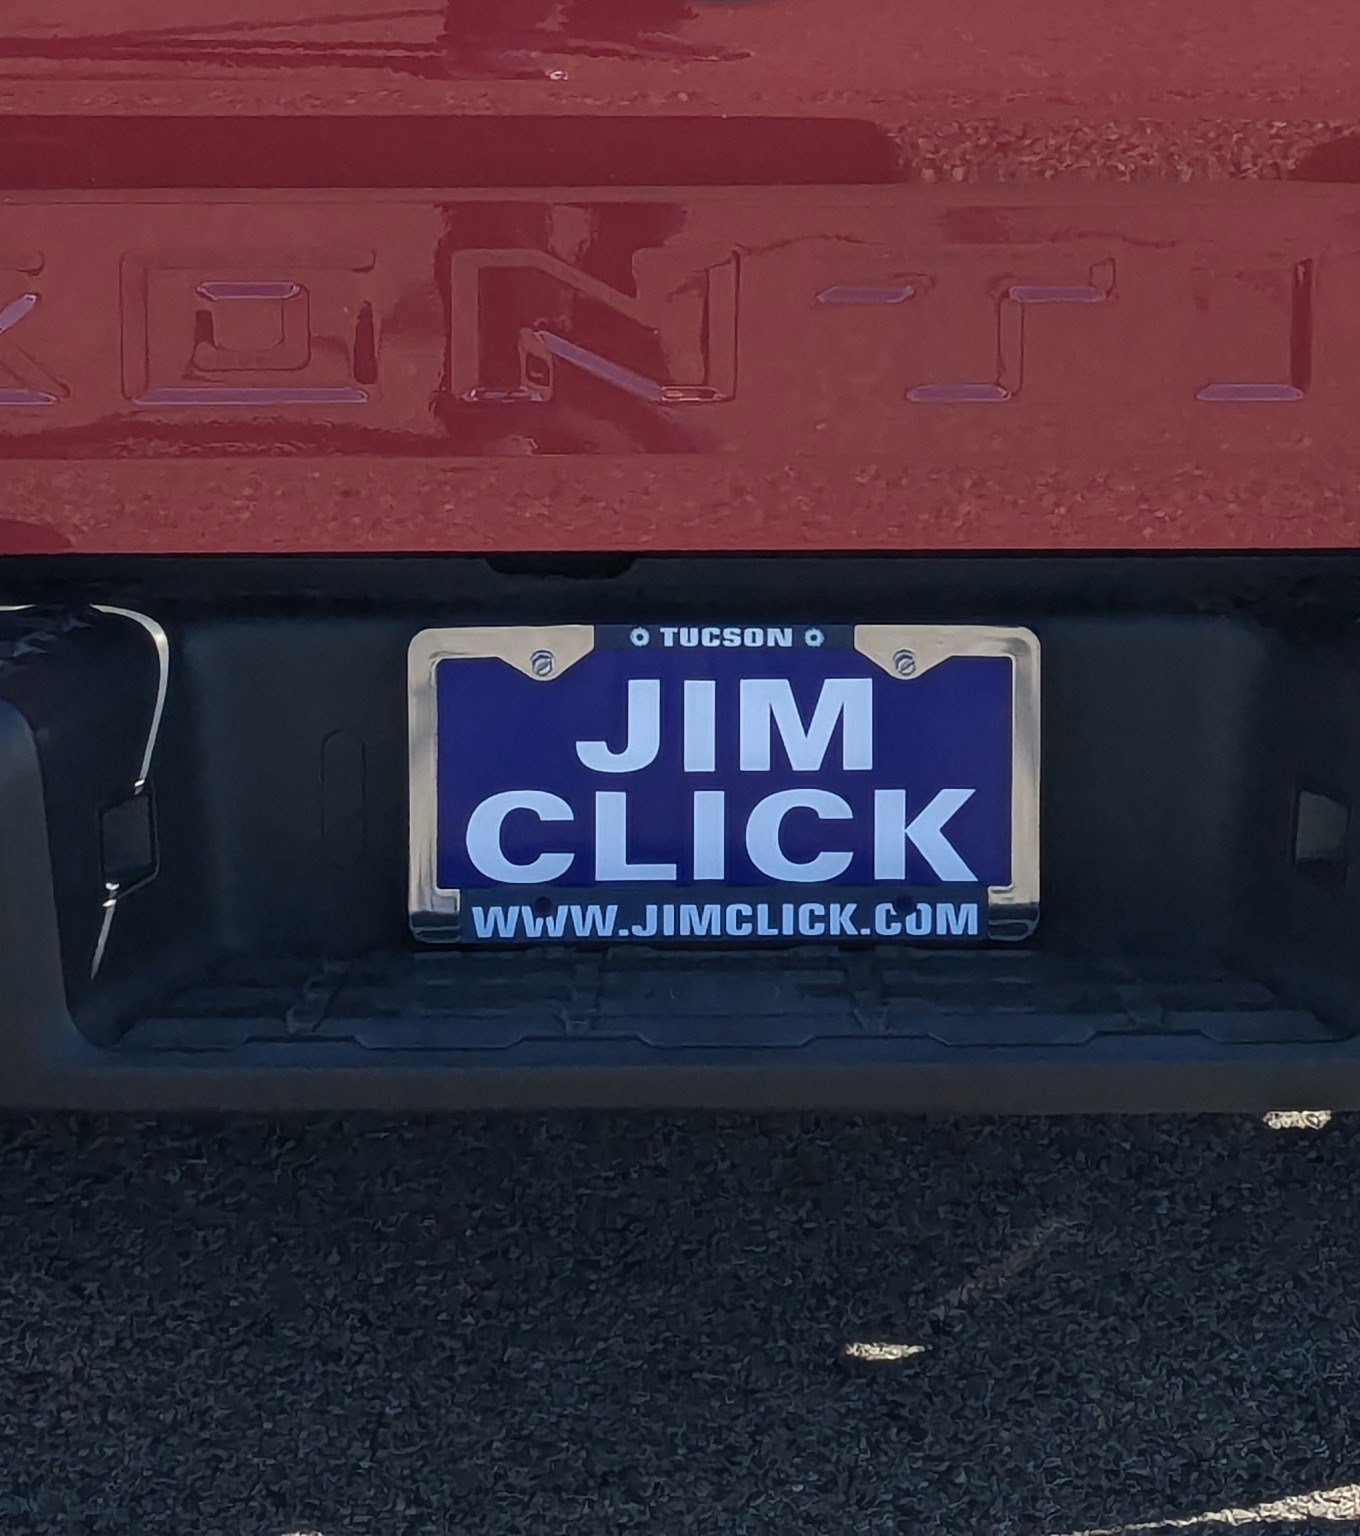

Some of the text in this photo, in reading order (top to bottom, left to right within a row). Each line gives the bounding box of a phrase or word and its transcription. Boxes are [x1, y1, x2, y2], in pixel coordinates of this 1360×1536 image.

[659, 626, 794, 648] TUCSON
[575, 677, 874, 773] JIM
[465, 788, 979, 884] CLICK
[472, 902, 979, 939] WWW.JIMCLICK.COM
